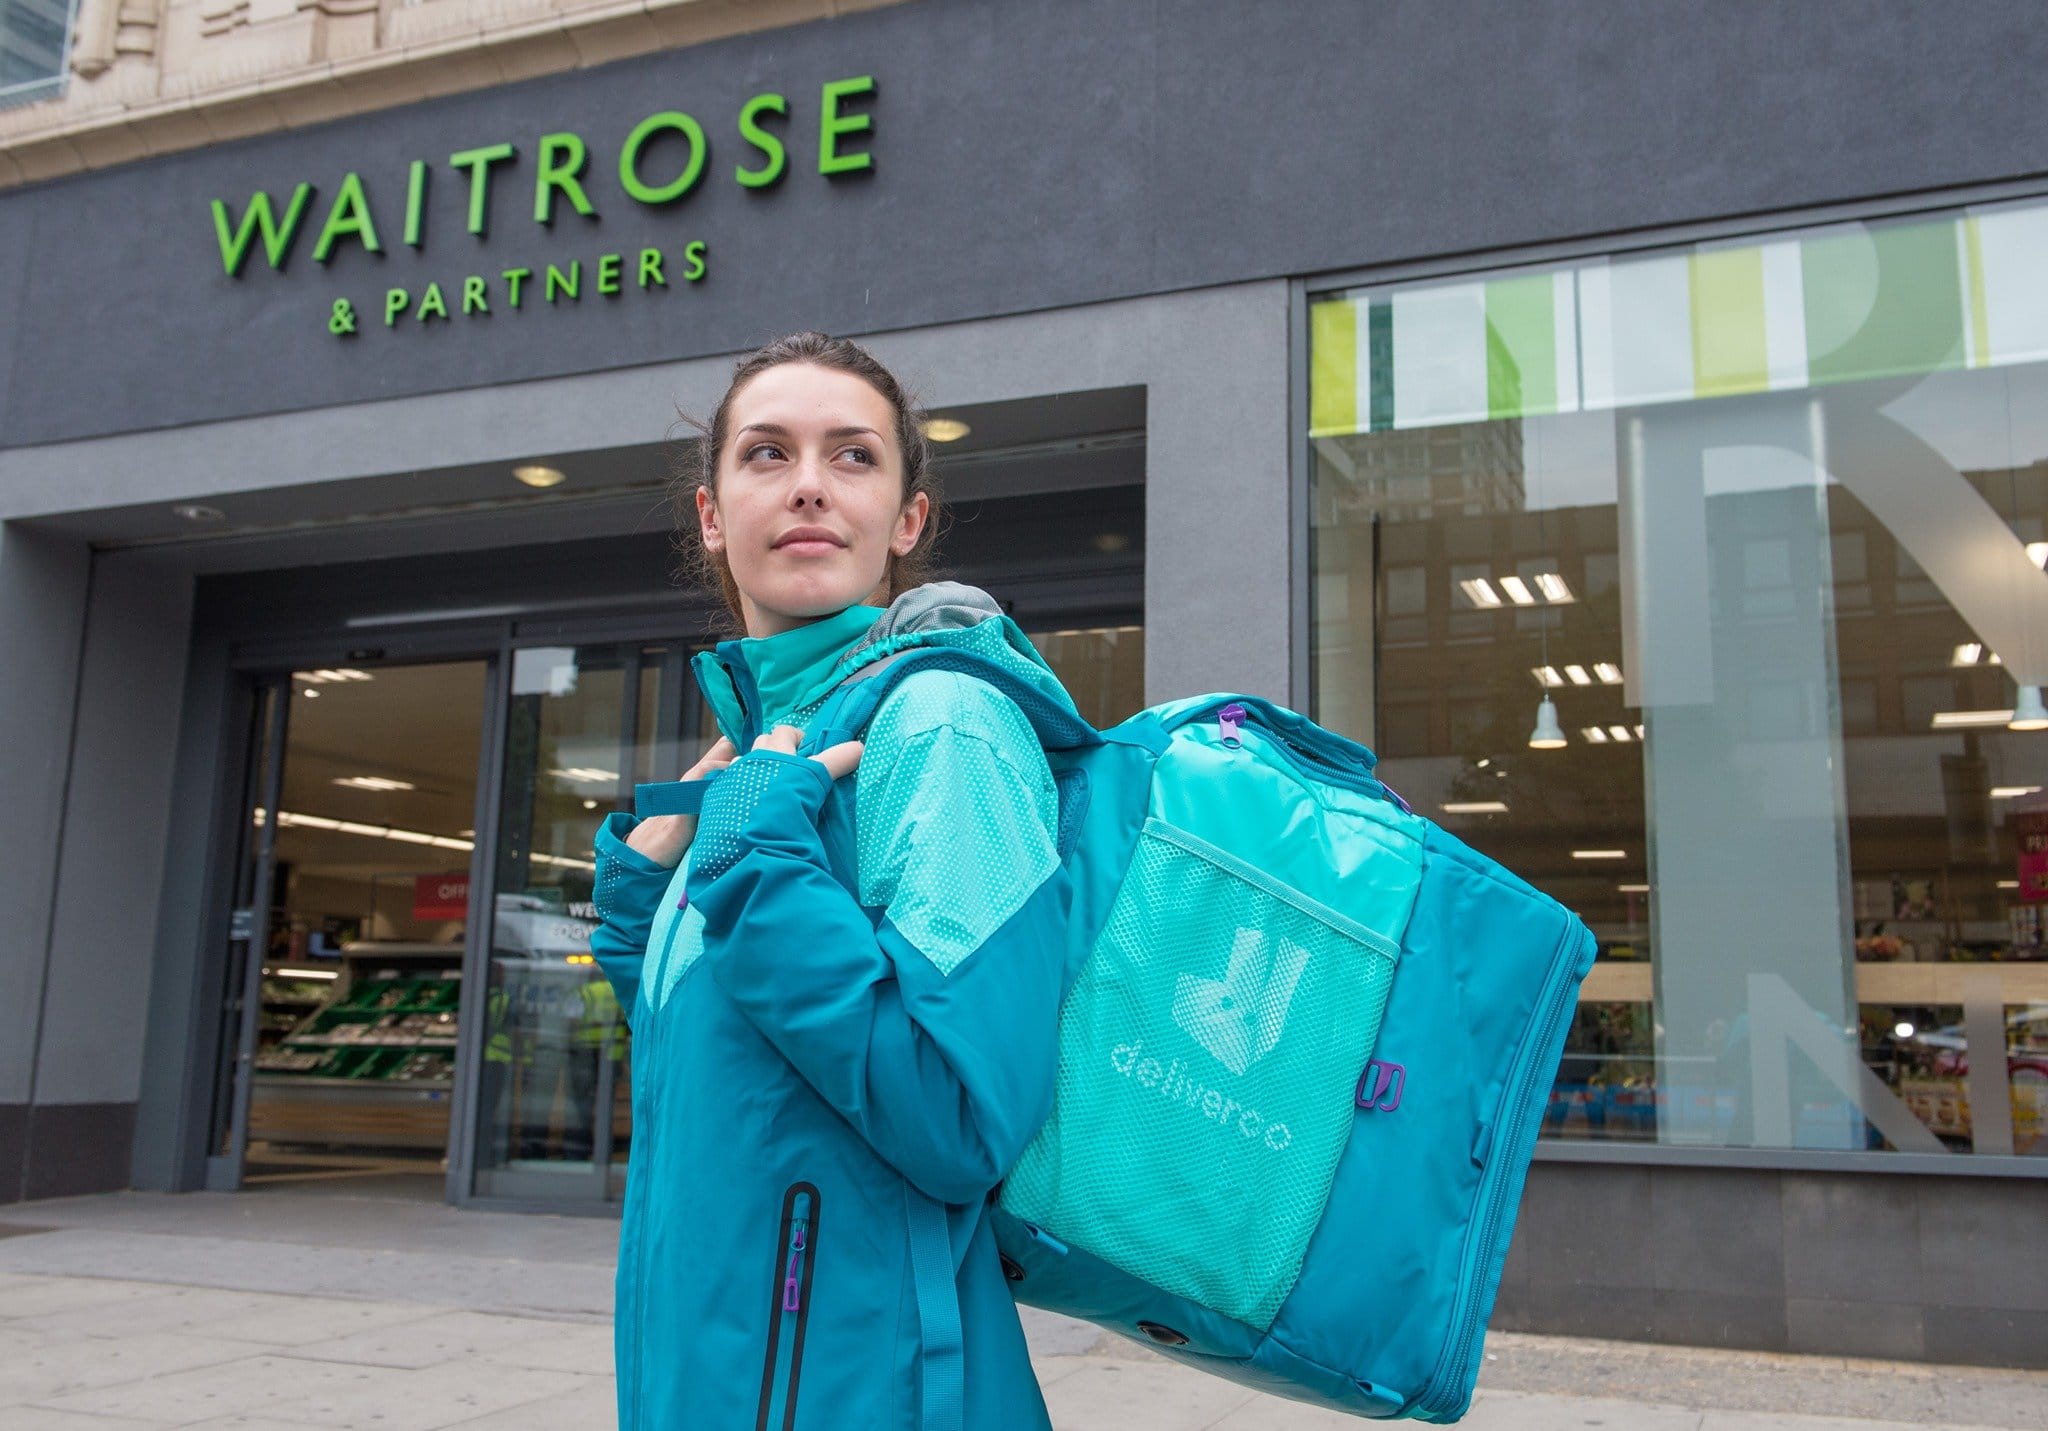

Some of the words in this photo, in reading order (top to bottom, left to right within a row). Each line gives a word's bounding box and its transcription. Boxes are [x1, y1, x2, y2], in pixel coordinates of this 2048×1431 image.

[209, 75, 875, 277] WAITROSE
[327, 297, 357, 336] &
[384, 240, 708, 327] PARTNERS
[1111, 1039, 1292, 1151] deliveroo
